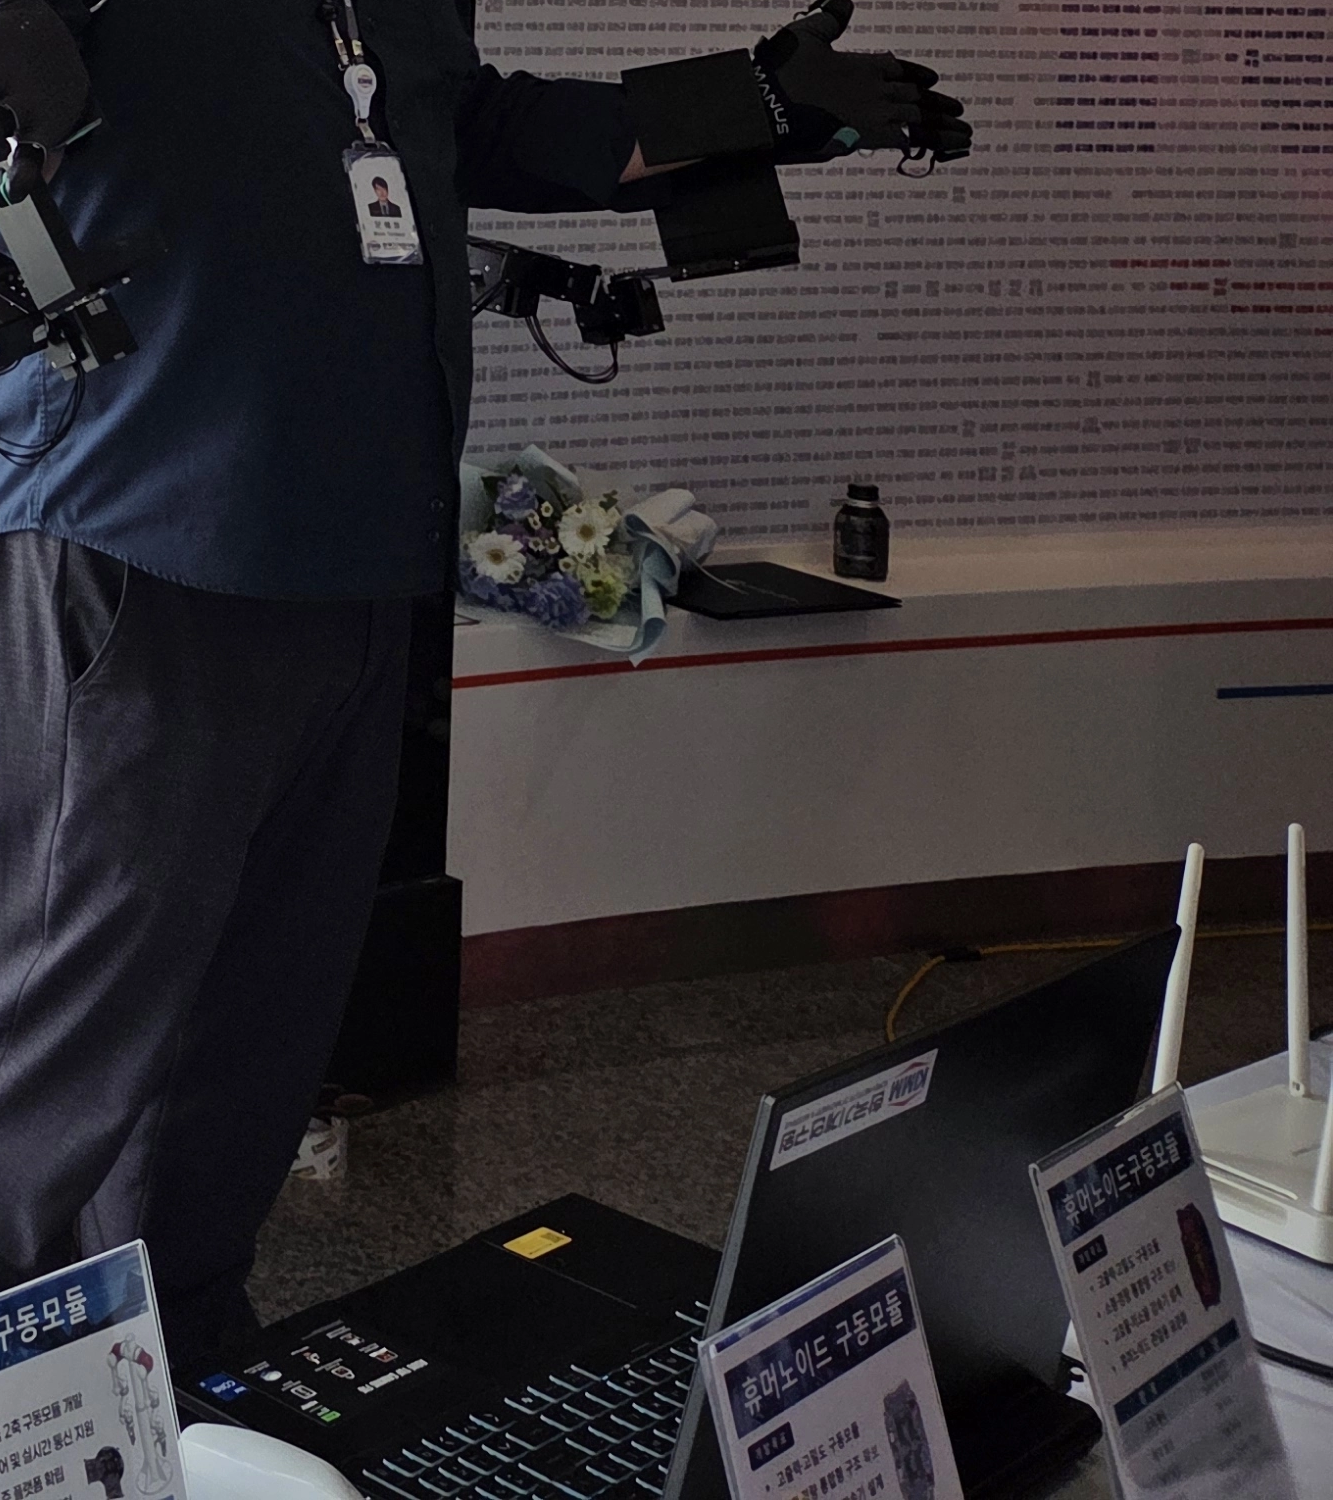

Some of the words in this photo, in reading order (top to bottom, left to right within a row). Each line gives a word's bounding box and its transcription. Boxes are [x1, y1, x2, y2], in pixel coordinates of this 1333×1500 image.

[888, 1066, 929, 1102] KIMM
[1062, 1163, 1131, 1227] 휴머노이드
[742, 1335, 832, 1416] 휴머노이드
[835, 1289, 903, 1357] 구동모듈
